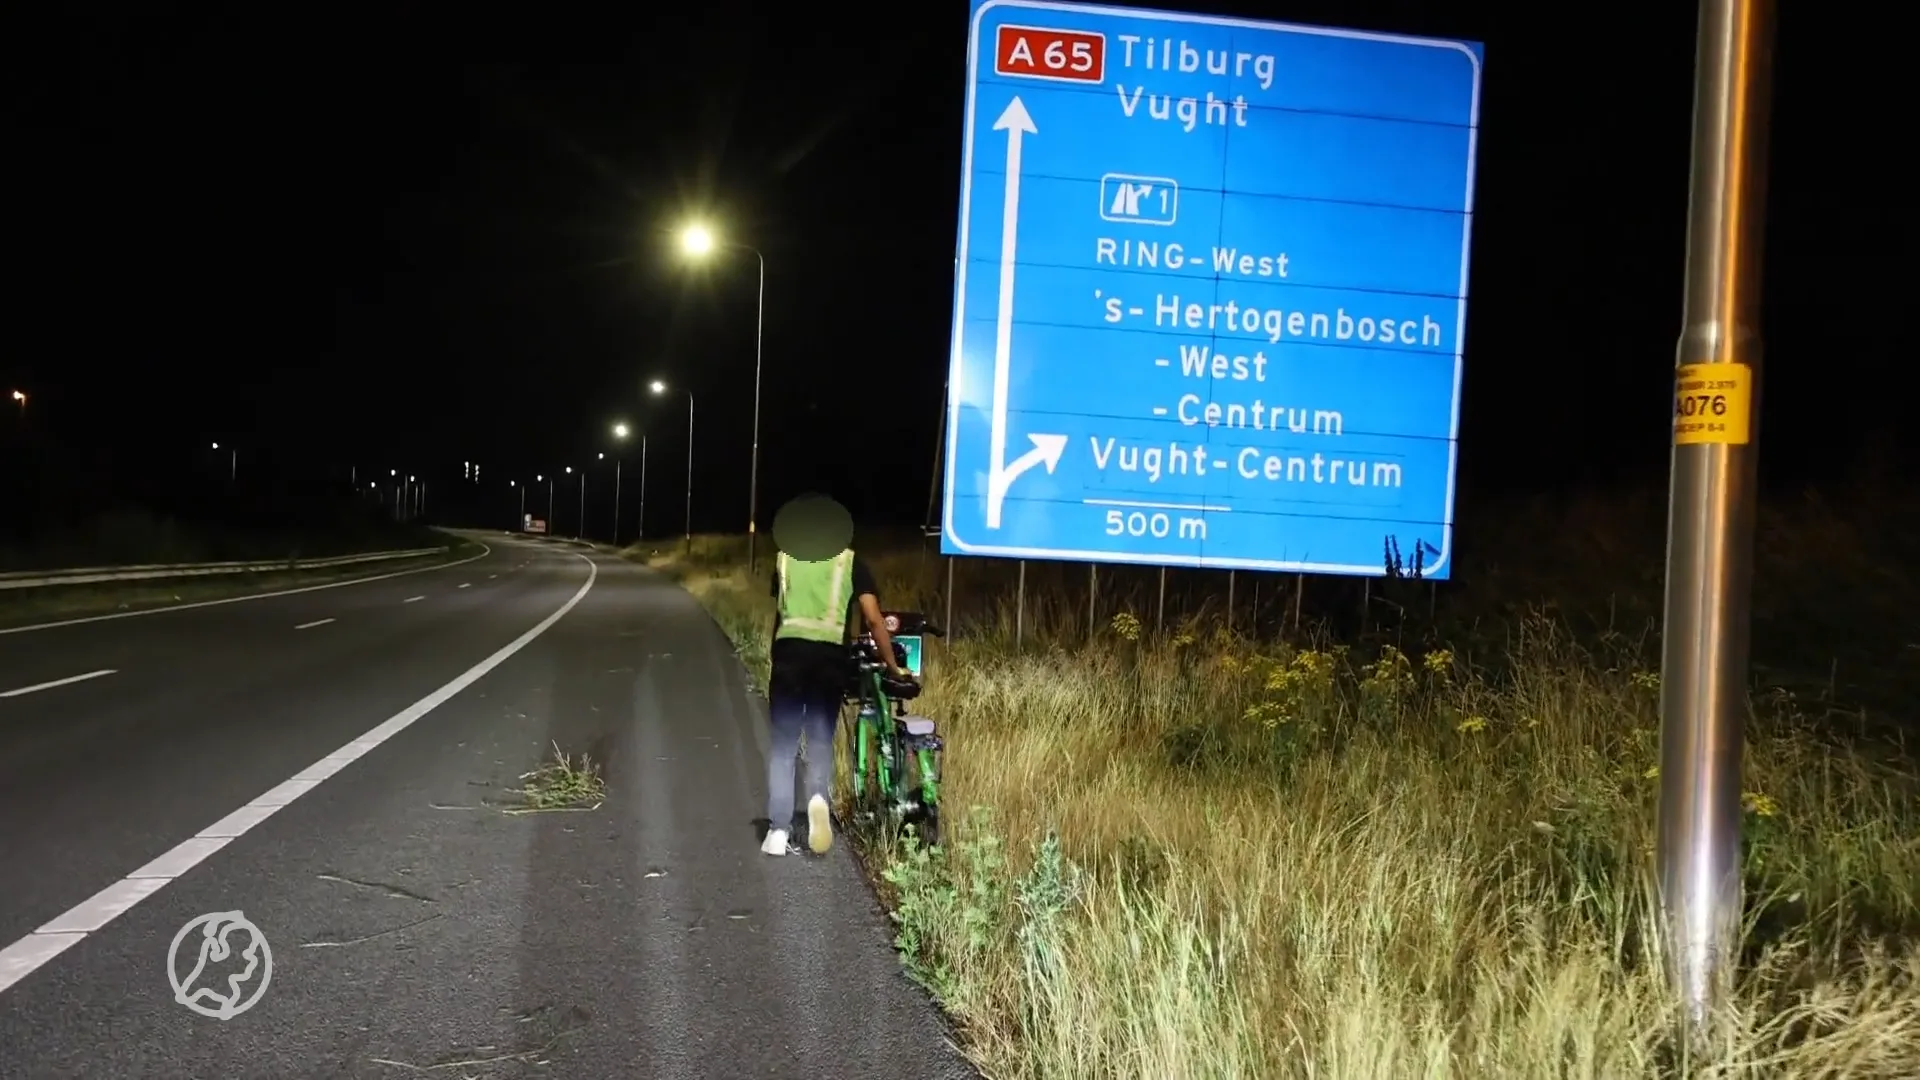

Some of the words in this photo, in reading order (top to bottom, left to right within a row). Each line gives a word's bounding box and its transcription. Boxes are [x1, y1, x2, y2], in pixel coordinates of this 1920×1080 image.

[1007, 37, 1035, 67] A
[1044, 40, 1094, 72] 65
[1117, 35, 1275, 89] Tilburg
[1116, 84, 1249, 132] Vught
[1158, 188, 1169, 214] 1
[1105, 510, 1170, 538] 500
[1178, 516, 1208, 541] m
